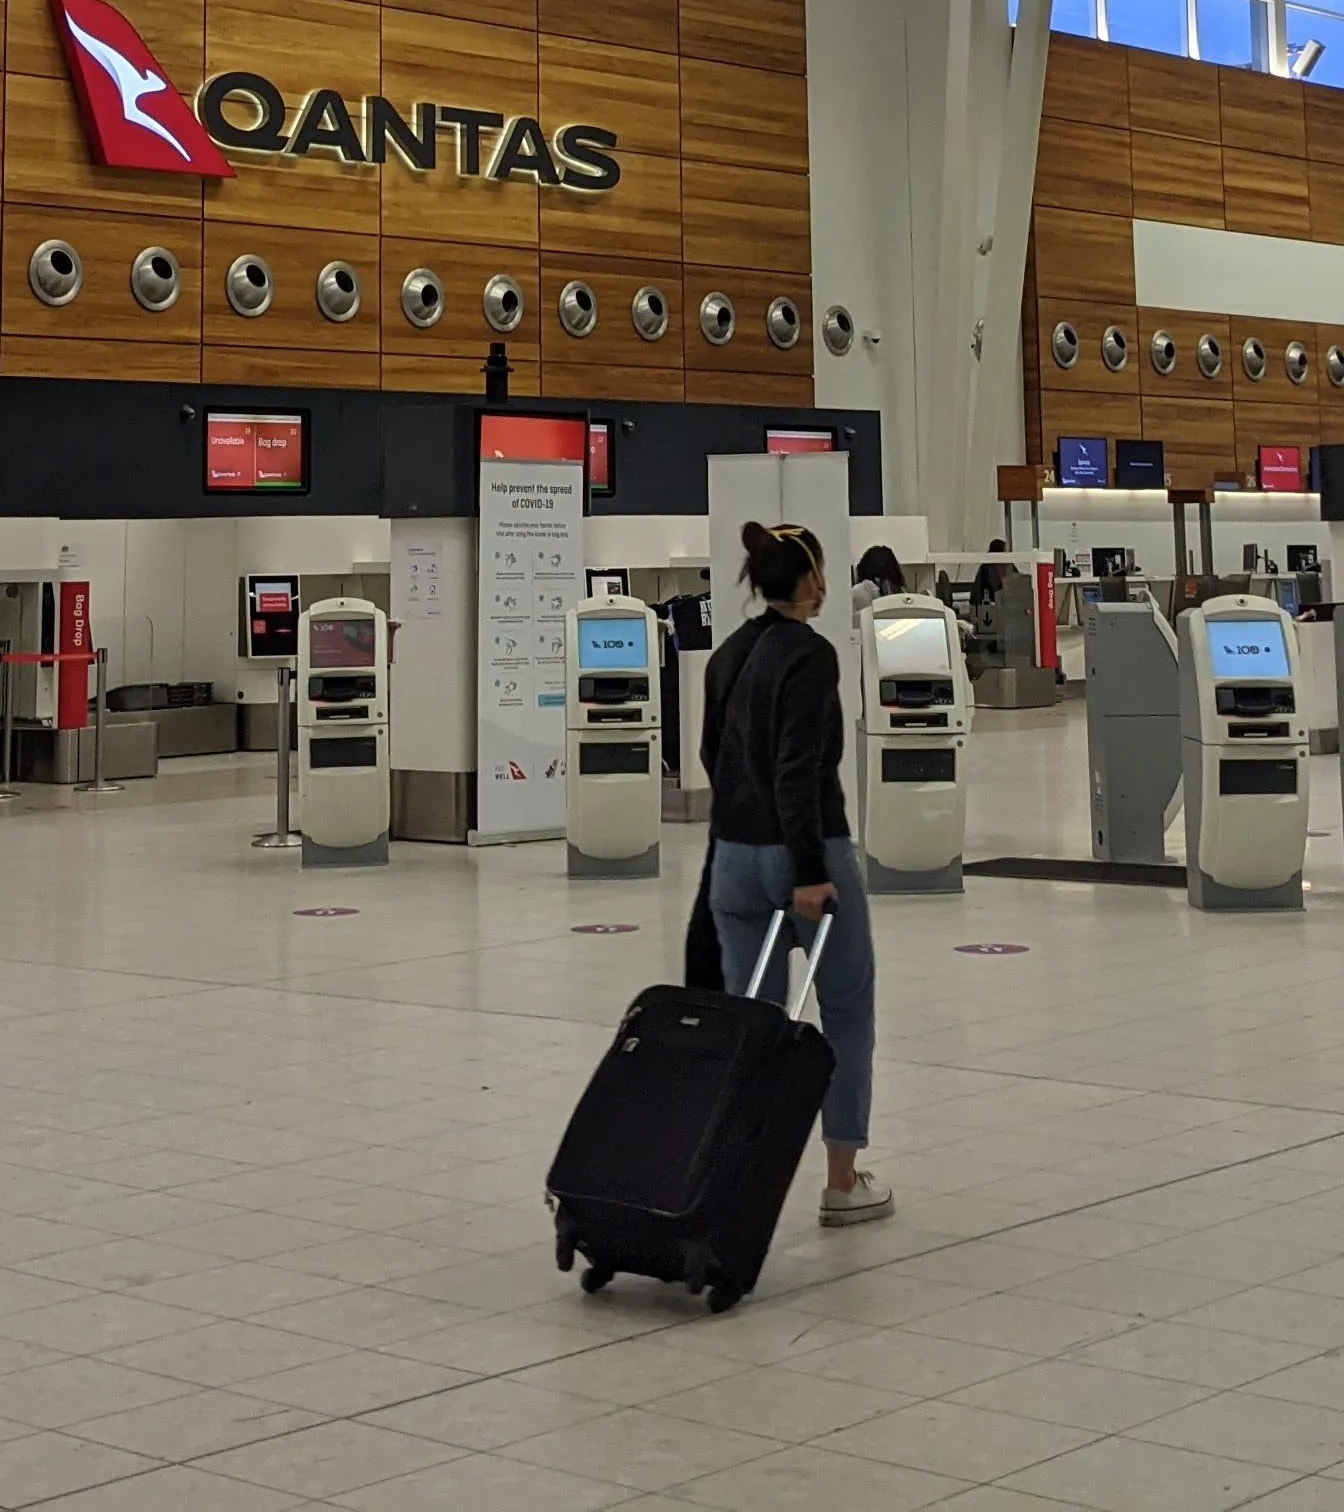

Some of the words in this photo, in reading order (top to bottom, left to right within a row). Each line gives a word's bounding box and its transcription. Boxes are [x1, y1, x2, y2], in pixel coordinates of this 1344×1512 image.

[197, 71, 621, 191] QANTAS
[258, 437, 271, 449] Bag
[1044, 469, 1055, 483] 24
[491, 482, 508, 495] Help
[508, 484, 535, 495] prevent
[536, 484, 549, 493] the
[549, 484, 572, 496] spread
[511, 498, 520, 508] of
[520, 498, 554, 509] COVID-19
[74, 594, 85, 617] Bag
[72, 619, 85, 647] Drop
